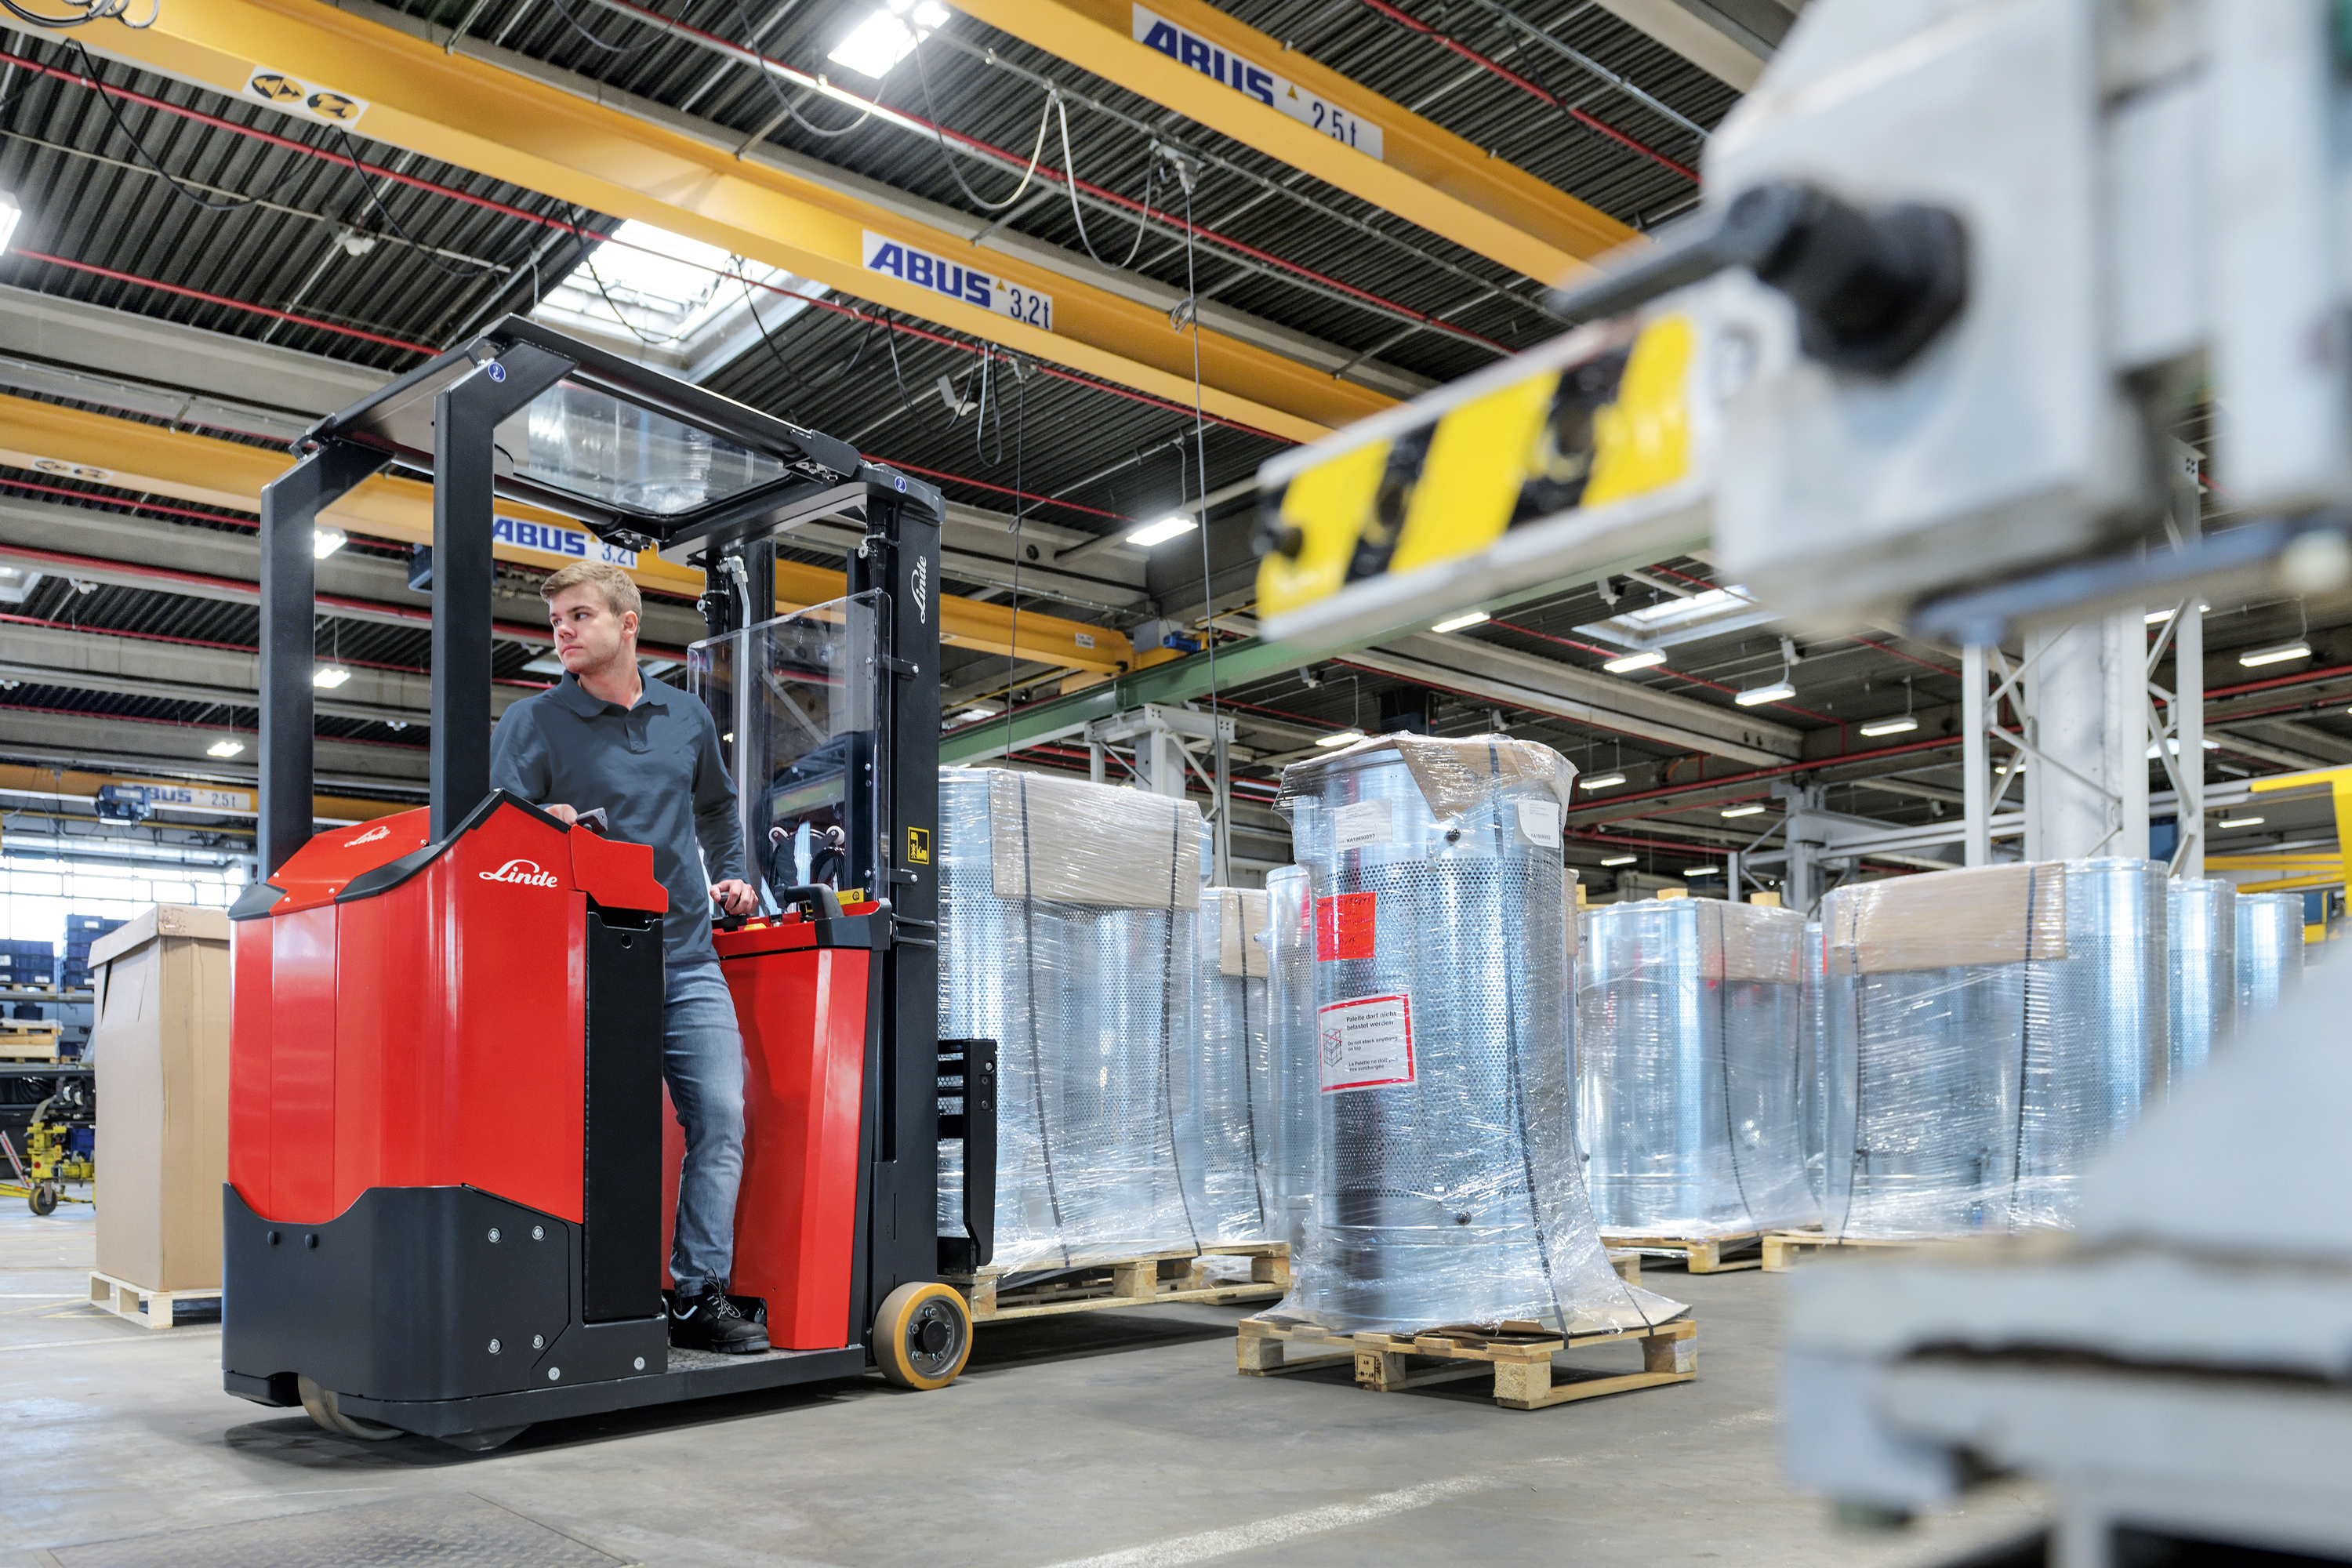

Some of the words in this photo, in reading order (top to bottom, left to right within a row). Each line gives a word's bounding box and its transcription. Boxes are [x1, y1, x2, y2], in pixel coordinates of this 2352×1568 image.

[1142, 20, 1274, 107] ABUS
[869, 241, 991, 308] ABUS
[492, 518, 586, 557] ABUS
[911, 555, 927, 625] Linde
[478, 859, 557, 888] Linde
